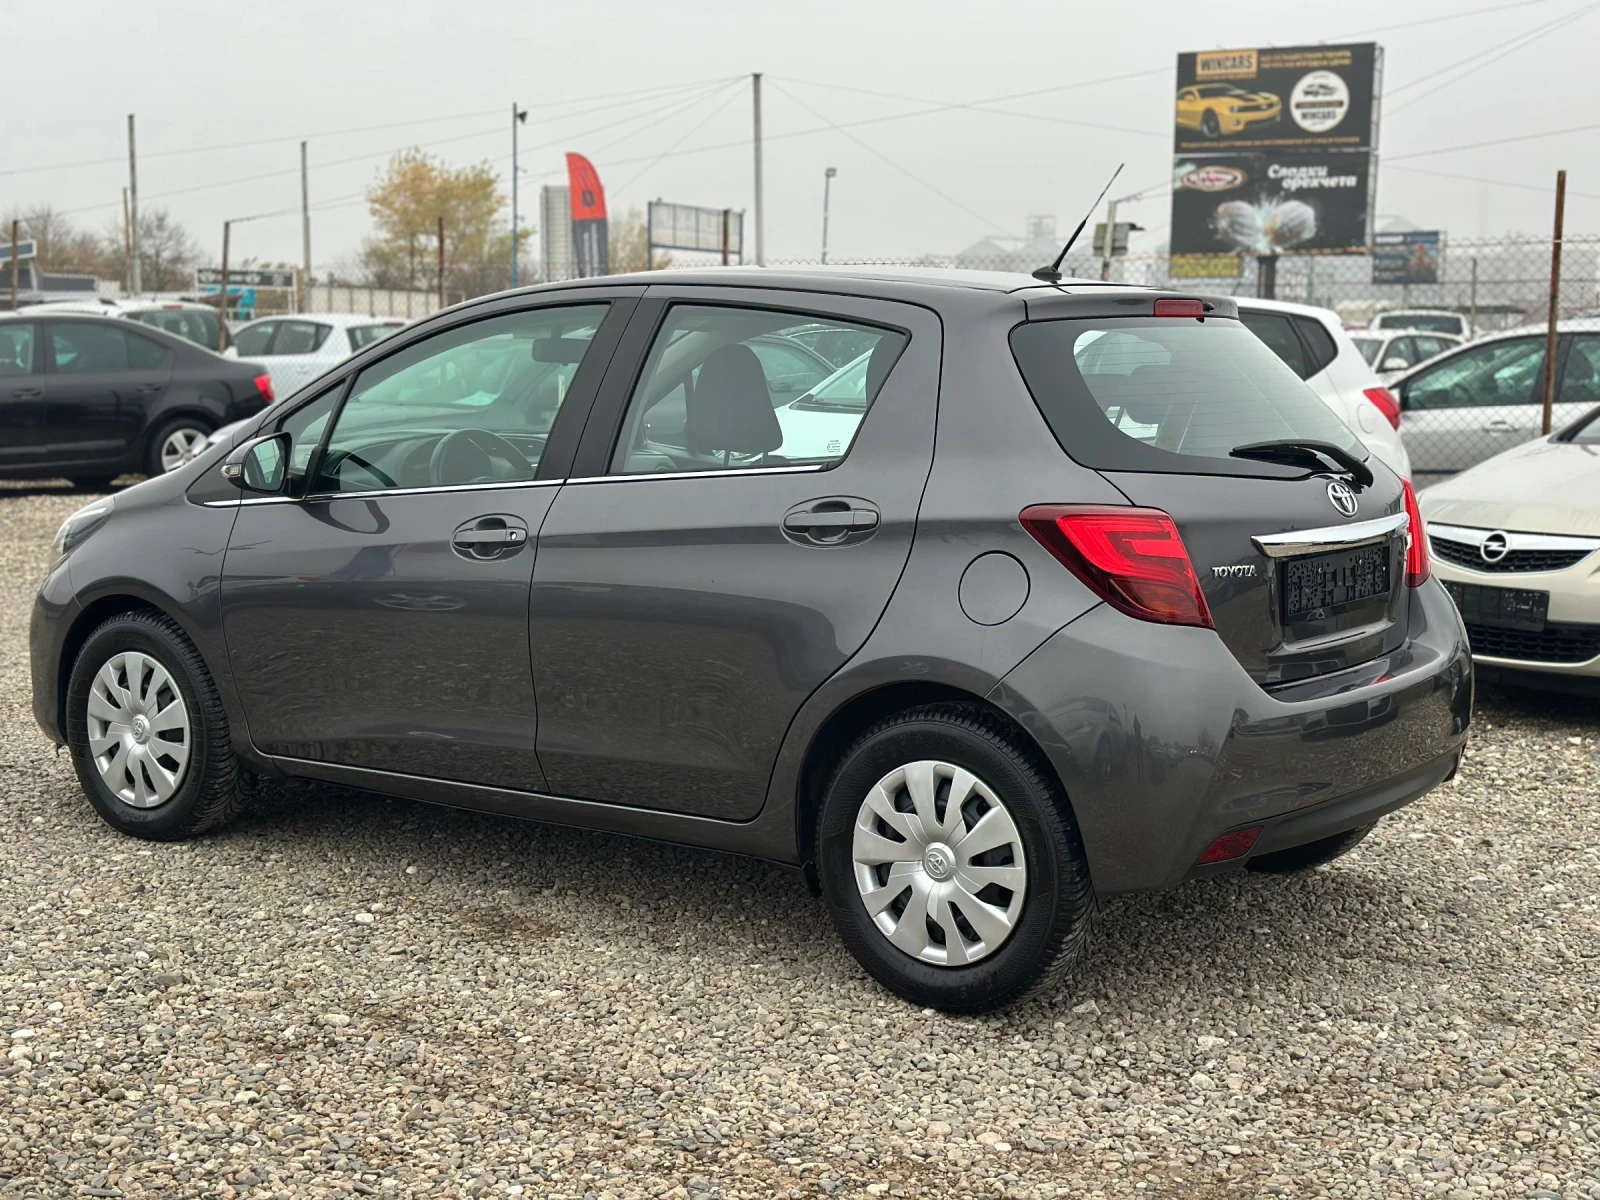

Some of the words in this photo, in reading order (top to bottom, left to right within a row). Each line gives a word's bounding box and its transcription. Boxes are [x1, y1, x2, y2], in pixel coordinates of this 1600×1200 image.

[1201, 55, 1253, 71] WINCARS
[1266, 163, 1329, 179] Сладки
[1281, 175, 1358, 192] орехчета
[1211, 564, 1258, 579] TOYOTA
